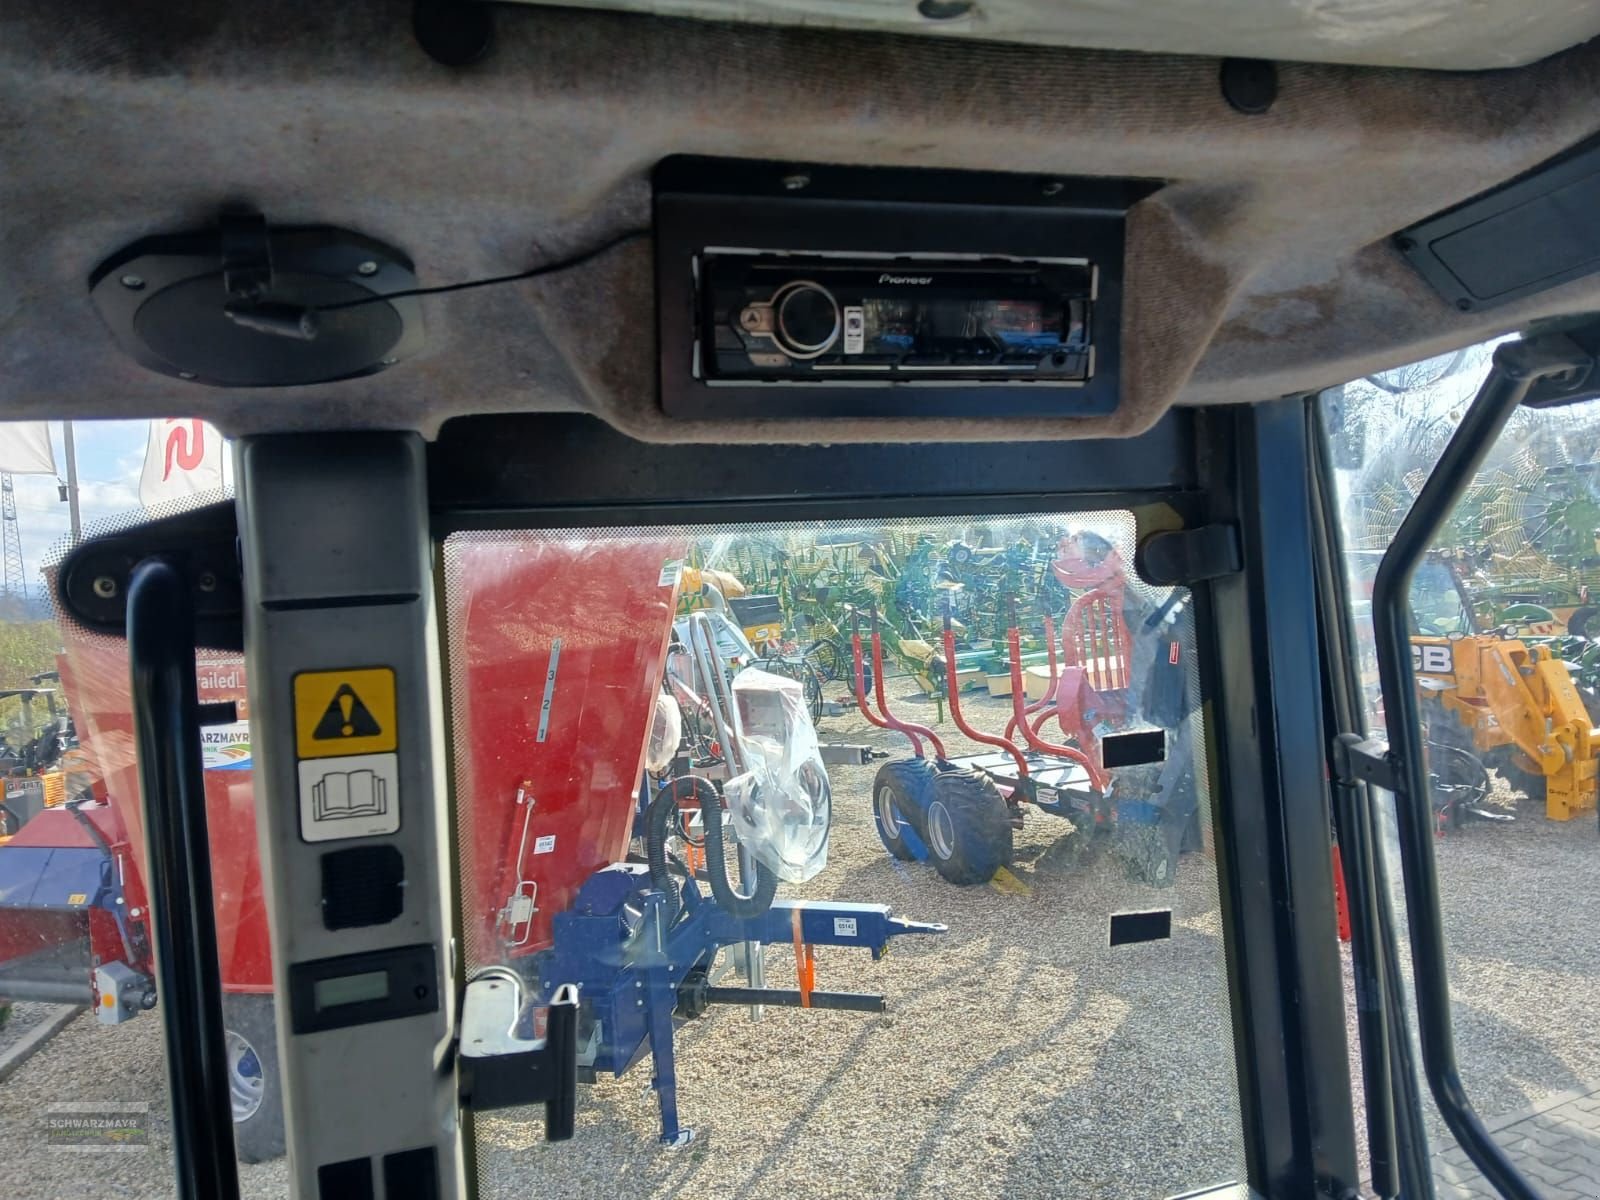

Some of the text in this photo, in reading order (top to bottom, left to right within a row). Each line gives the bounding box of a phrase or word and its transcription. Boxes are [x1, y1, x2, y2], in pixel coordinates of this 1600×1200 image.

[878, 273, 933, 285] Pioneer
[198, 671, 236, 689] ailed
[547, 670, 555, 681] 3
[542, 699, 550, 710] 2
[200, 733, 250, 743] ARZMAYR
